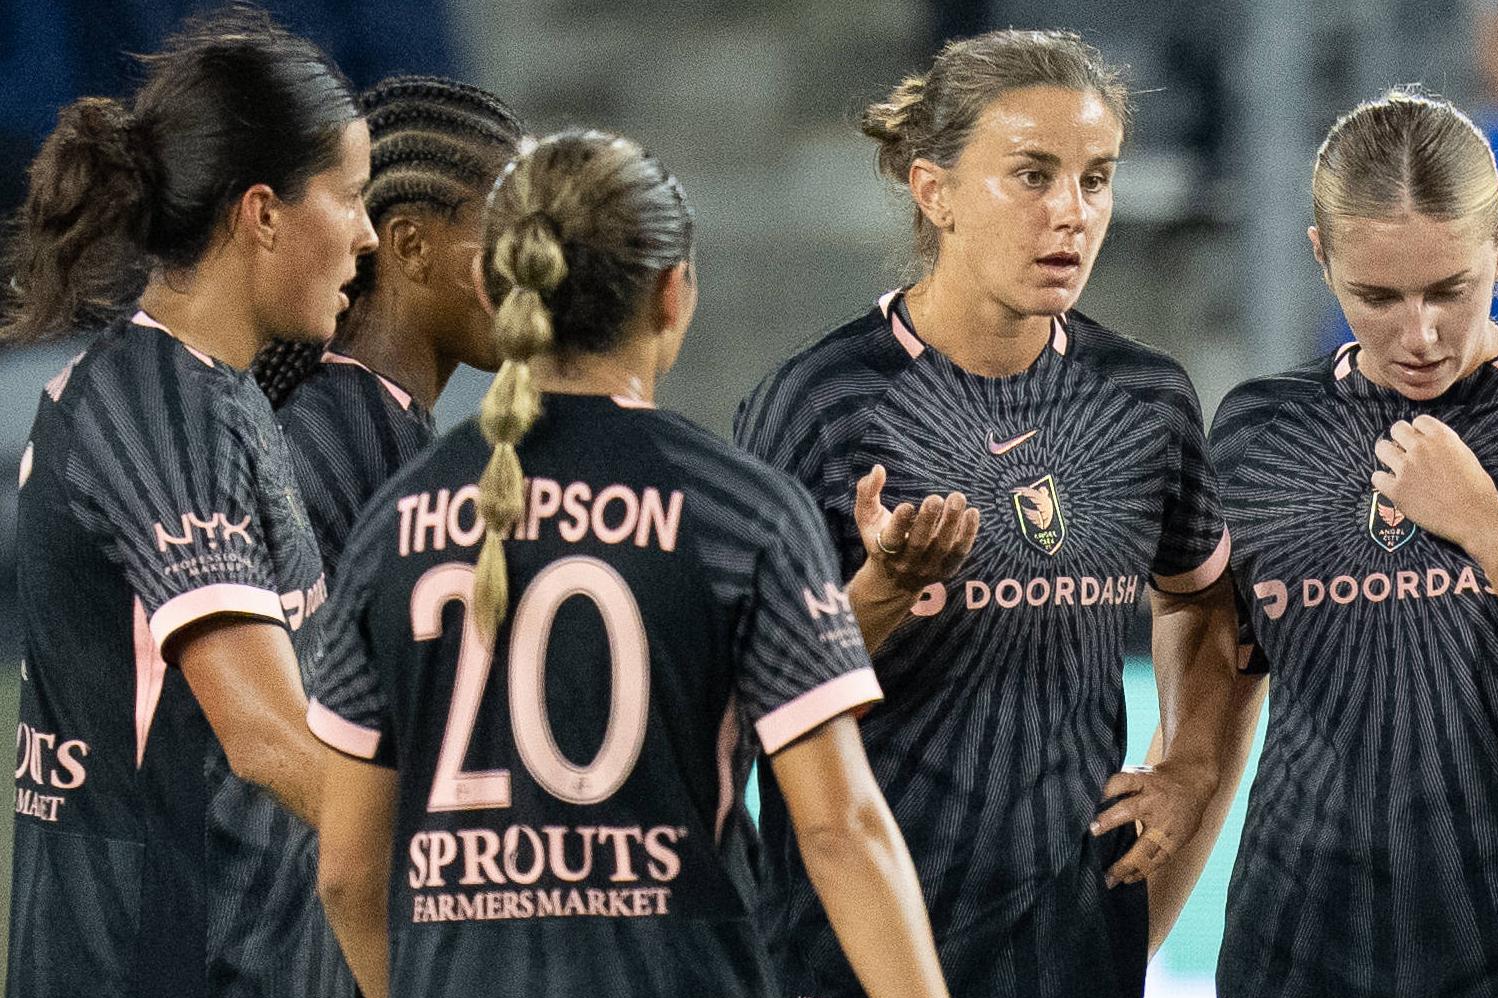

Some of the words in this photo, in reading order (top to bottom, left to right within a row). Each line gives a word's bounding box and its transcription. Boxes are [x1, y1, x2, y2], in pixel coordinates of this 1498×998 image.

[154, 512, 251, 552] NYX
[396, 477, 684, 557] THOPSON
[803, 582, 855, 622] NY
[965, 574, 1138, 609] DOORDASH
[1303, 566, 1496, 607] DOORDA
[410, 555, 650, 813] 20
[409, 824, 682, 889] SPROUTS
[412, 892, 535, 923] FARMERS
[536, 887, 671, 917] MARKET
